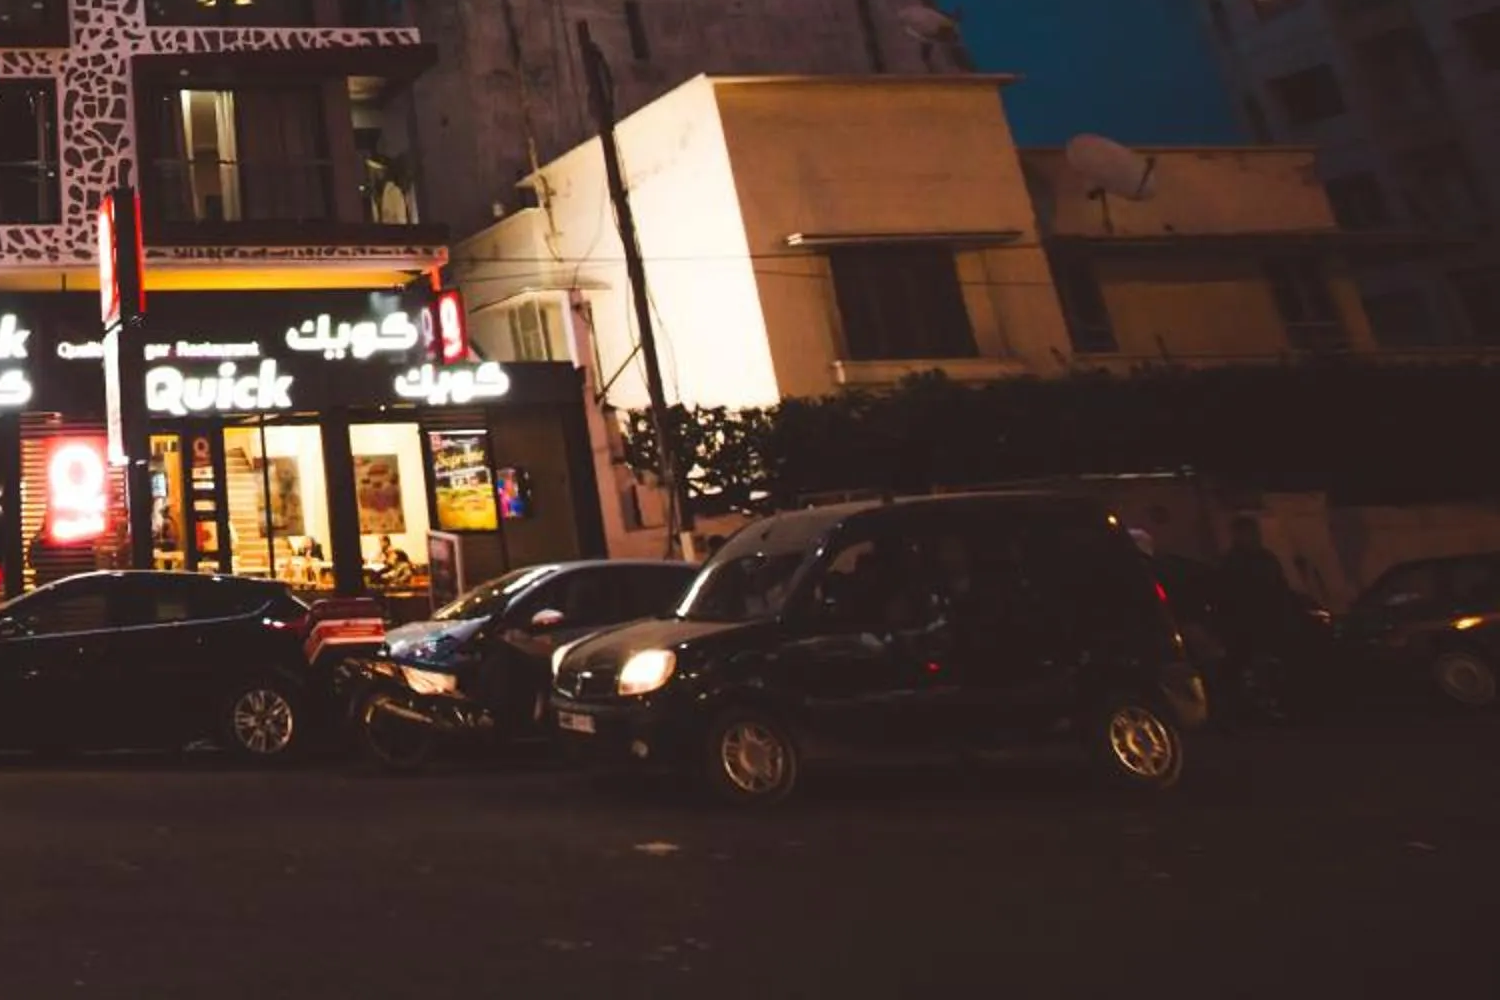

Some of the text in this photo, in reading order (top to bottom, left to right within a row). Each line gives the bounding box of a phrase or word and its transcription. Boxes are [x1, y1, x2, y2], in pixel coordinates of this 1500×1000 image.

[286, 312, 419, 360] كويك
[146, 359, 293, 415] Quick
[395, 362, 510, 405] كويك
